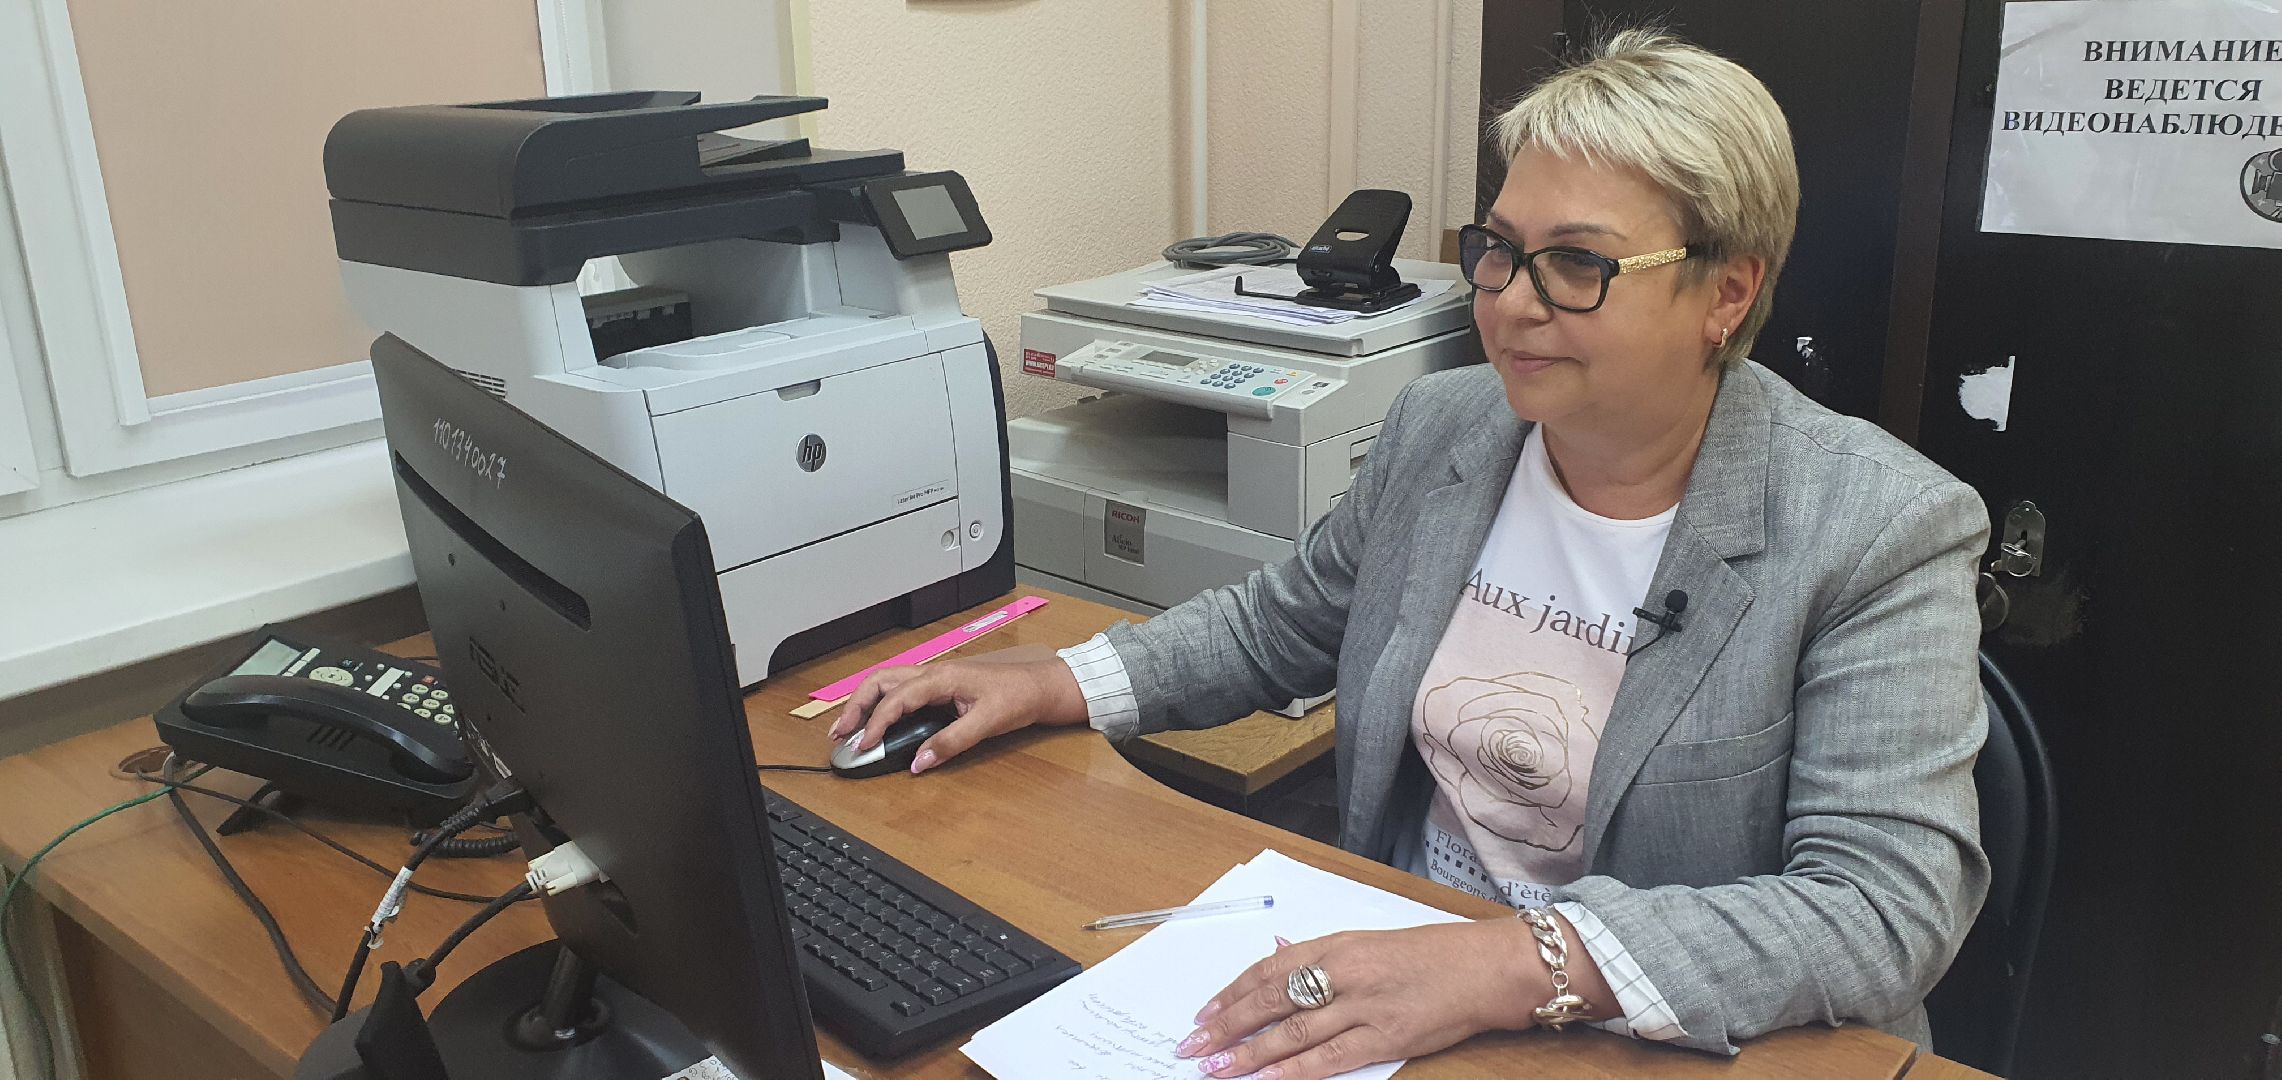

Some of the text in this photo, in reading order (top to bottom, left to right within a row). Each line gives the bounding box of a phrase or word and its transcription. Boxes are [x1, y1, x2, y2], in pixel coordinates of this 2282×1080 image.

[2104, 78, 2263, 105] ВЕДЕТСЯ
[801, 434, 823, 472] hp
[1111, 510, 1140, 524] RICOH
[1459, 567, 1531, 620] Aux
[1430, 858, 1487, 899] Bourgeons
